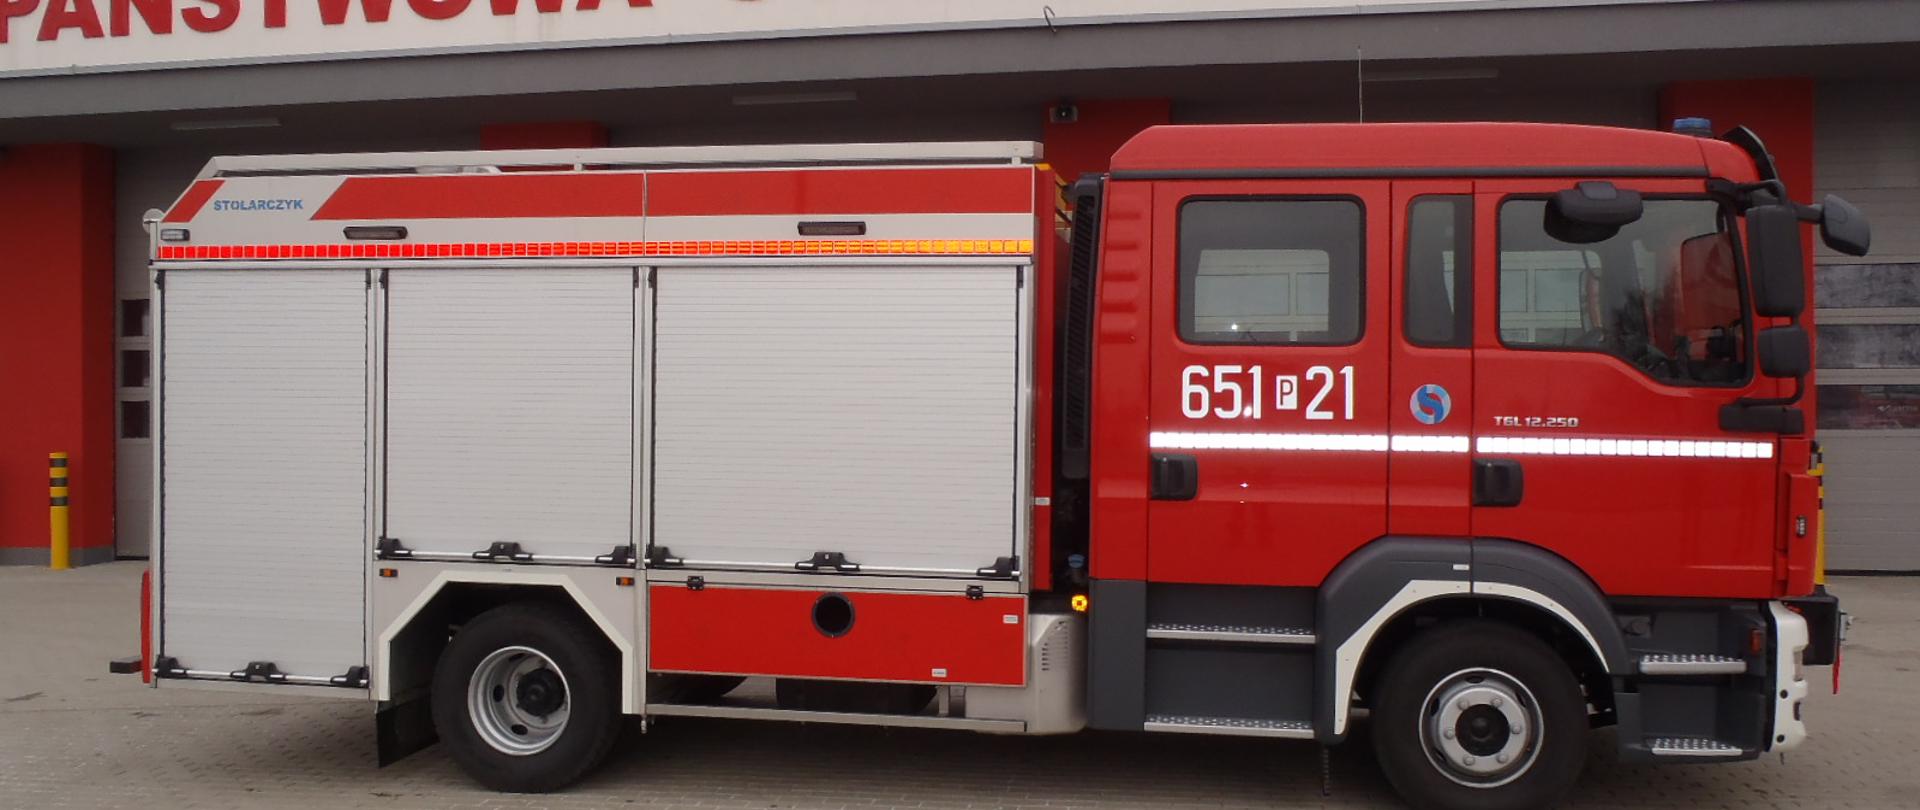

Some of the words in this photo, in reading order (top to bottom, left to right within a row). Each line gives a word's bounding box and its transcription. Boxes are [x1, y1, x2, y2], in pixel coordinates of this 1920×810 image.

[213, 199, 303, 211] STOLARCZYK
[1182, 365, 1262, 419] 651
[1280, 379, 1294, 406] P
[1305, 365, 1354, 420] 21
[1493, 416, 1522, 427] TGL
[1524, 416, 1579, 428] 12.250
